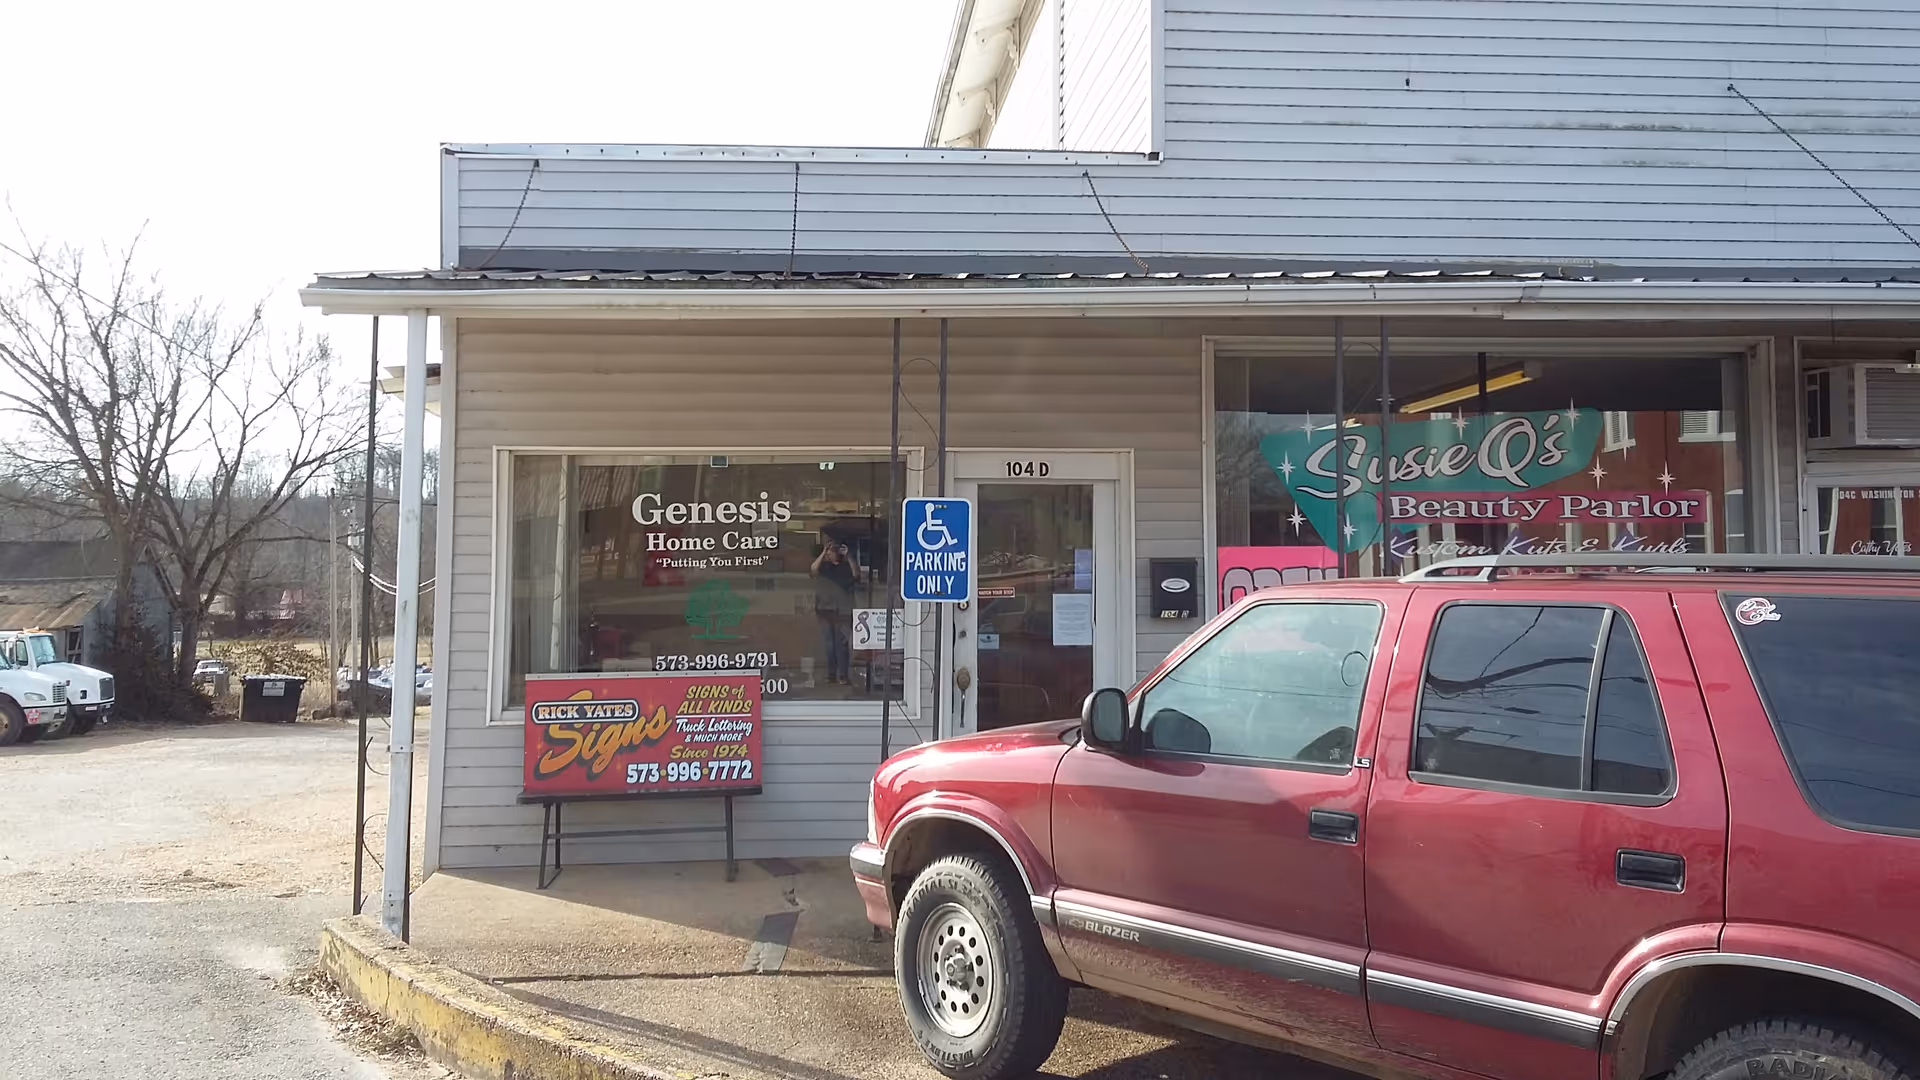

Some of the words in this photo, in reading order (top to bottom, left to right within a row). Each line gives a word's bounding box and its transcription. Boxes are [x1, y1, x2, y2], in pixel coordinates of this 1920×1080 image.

[1296, 433, 1476, 499] Susie
[1476, 413, 1570, 488] Q's
[1005, 461, 1035, 477] 104
[1039, 461, 1050, 477] D
[631, 491, 792, 526] Genesis
[1389, 495, 1551, 521] Beauty
[1558, 494, 1700, 519] Parlor
[645, 532, 716, 552] Home
[722, 530, 778, 550] Care
[1389, 535, 1493, 558] Kustom
[1499, 535, 1566, 556] Kuts
[1609, 535, 1692, 555] Kurls
[1850, 540, 1881, 556] Cathy
[709, 556, 732, 567] You
[905, 550, 967, 572] PARKING
[916, 574, 955, 595] ONLY
[655, 651, 779, 670] 573-996-9791
[686, 685, 730, 699] SIGNS
[731, 684, 745, 699] of
[537, 705, 580, 720] RICK
[583, 703, 634, 718] YATES
[676, 701, 703, 714] ALL
[707, 699, 752, 714] KINDS
[538, 688, 673, 775] Signs
[675, 718, 706, 733] Truck
[707, 717, 753, 736] Lettering
[684, 734, 692, 743] &
[693, 733, 718, 743] MUCH
[719, 732, 744, 742] MORE
[670, 745, 709, 759] Since
[712, 743, 748, 758] 1974
[1353, 756, 1371, 768] LS
[1084, 920, 1141, 942] BLAZER
